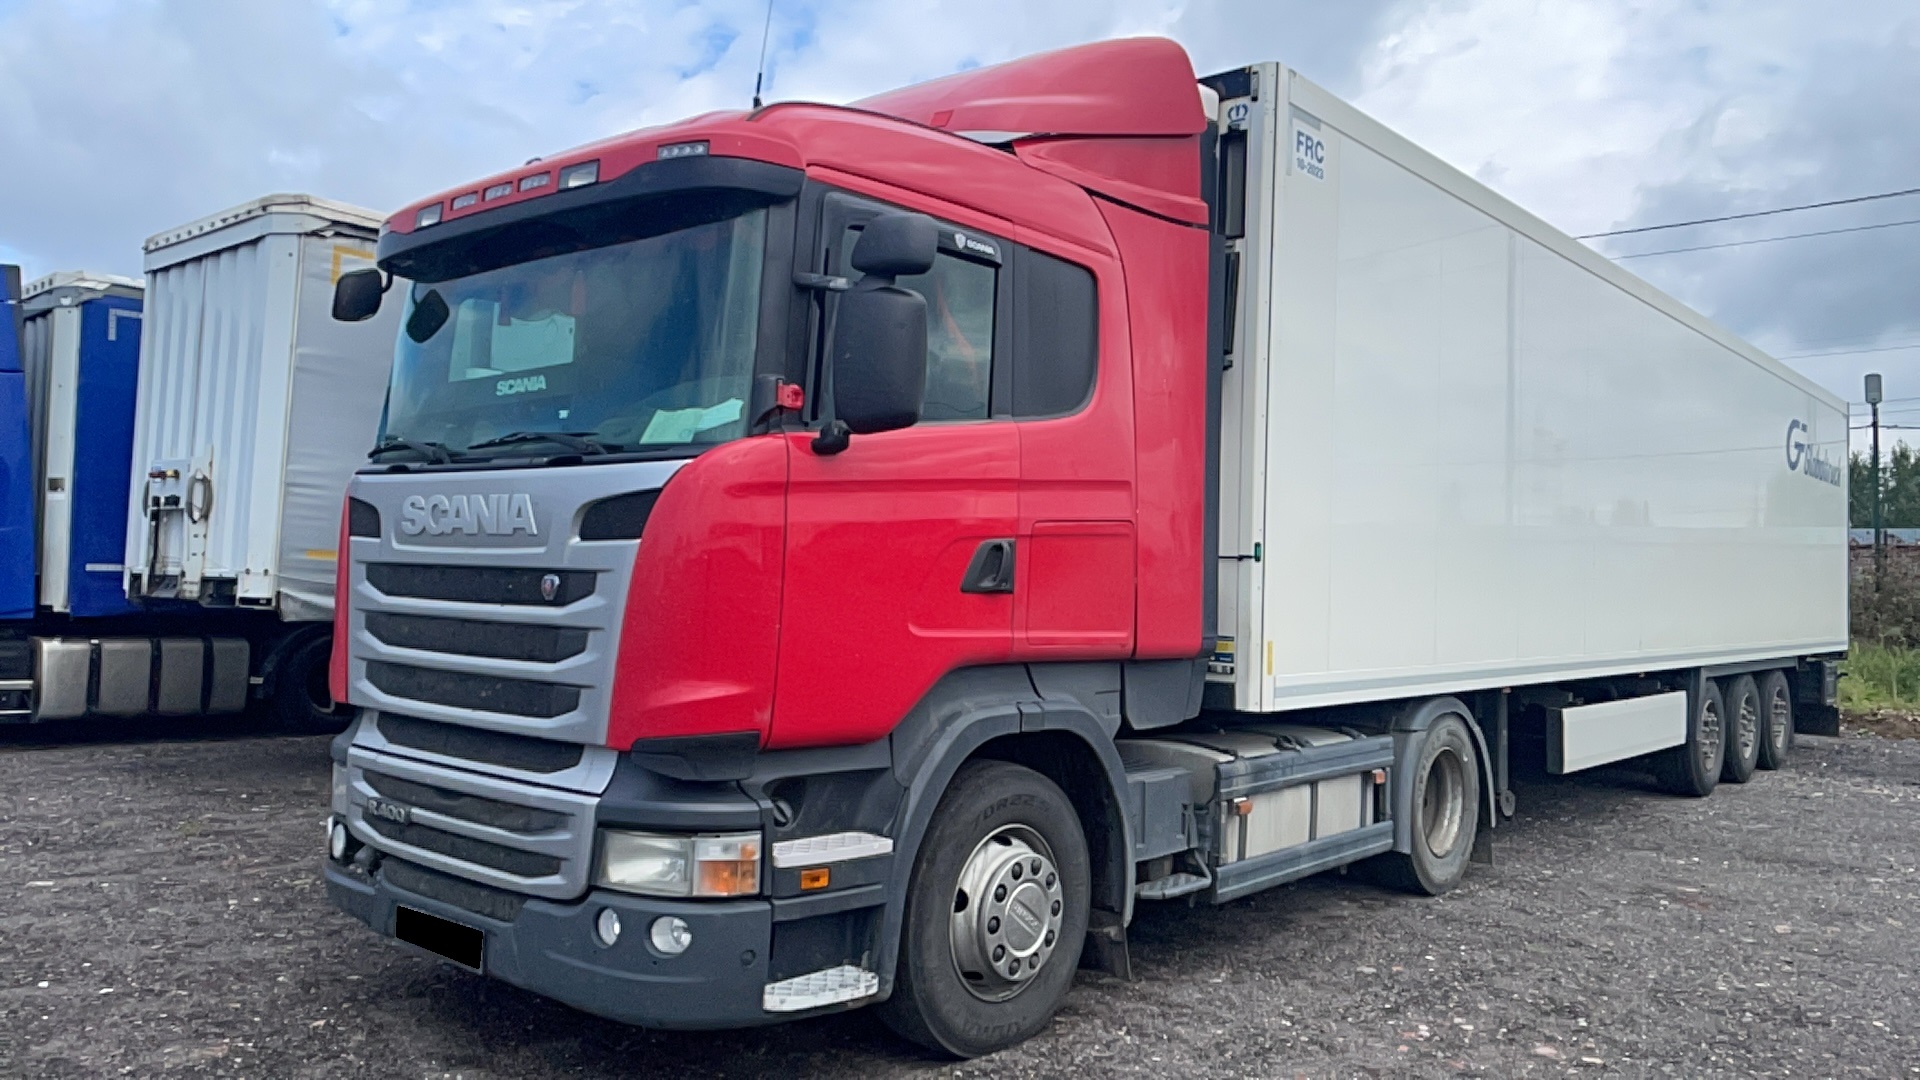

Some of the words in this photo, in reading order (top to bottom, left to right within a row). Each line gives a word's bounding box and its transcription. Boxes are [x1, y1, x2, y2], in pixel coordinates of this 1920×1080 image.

[1297, 130, 1324, 163] FRC
[495, 374, 547, 396] SCANIA
[401, 494, 538, 536] SCANIA
